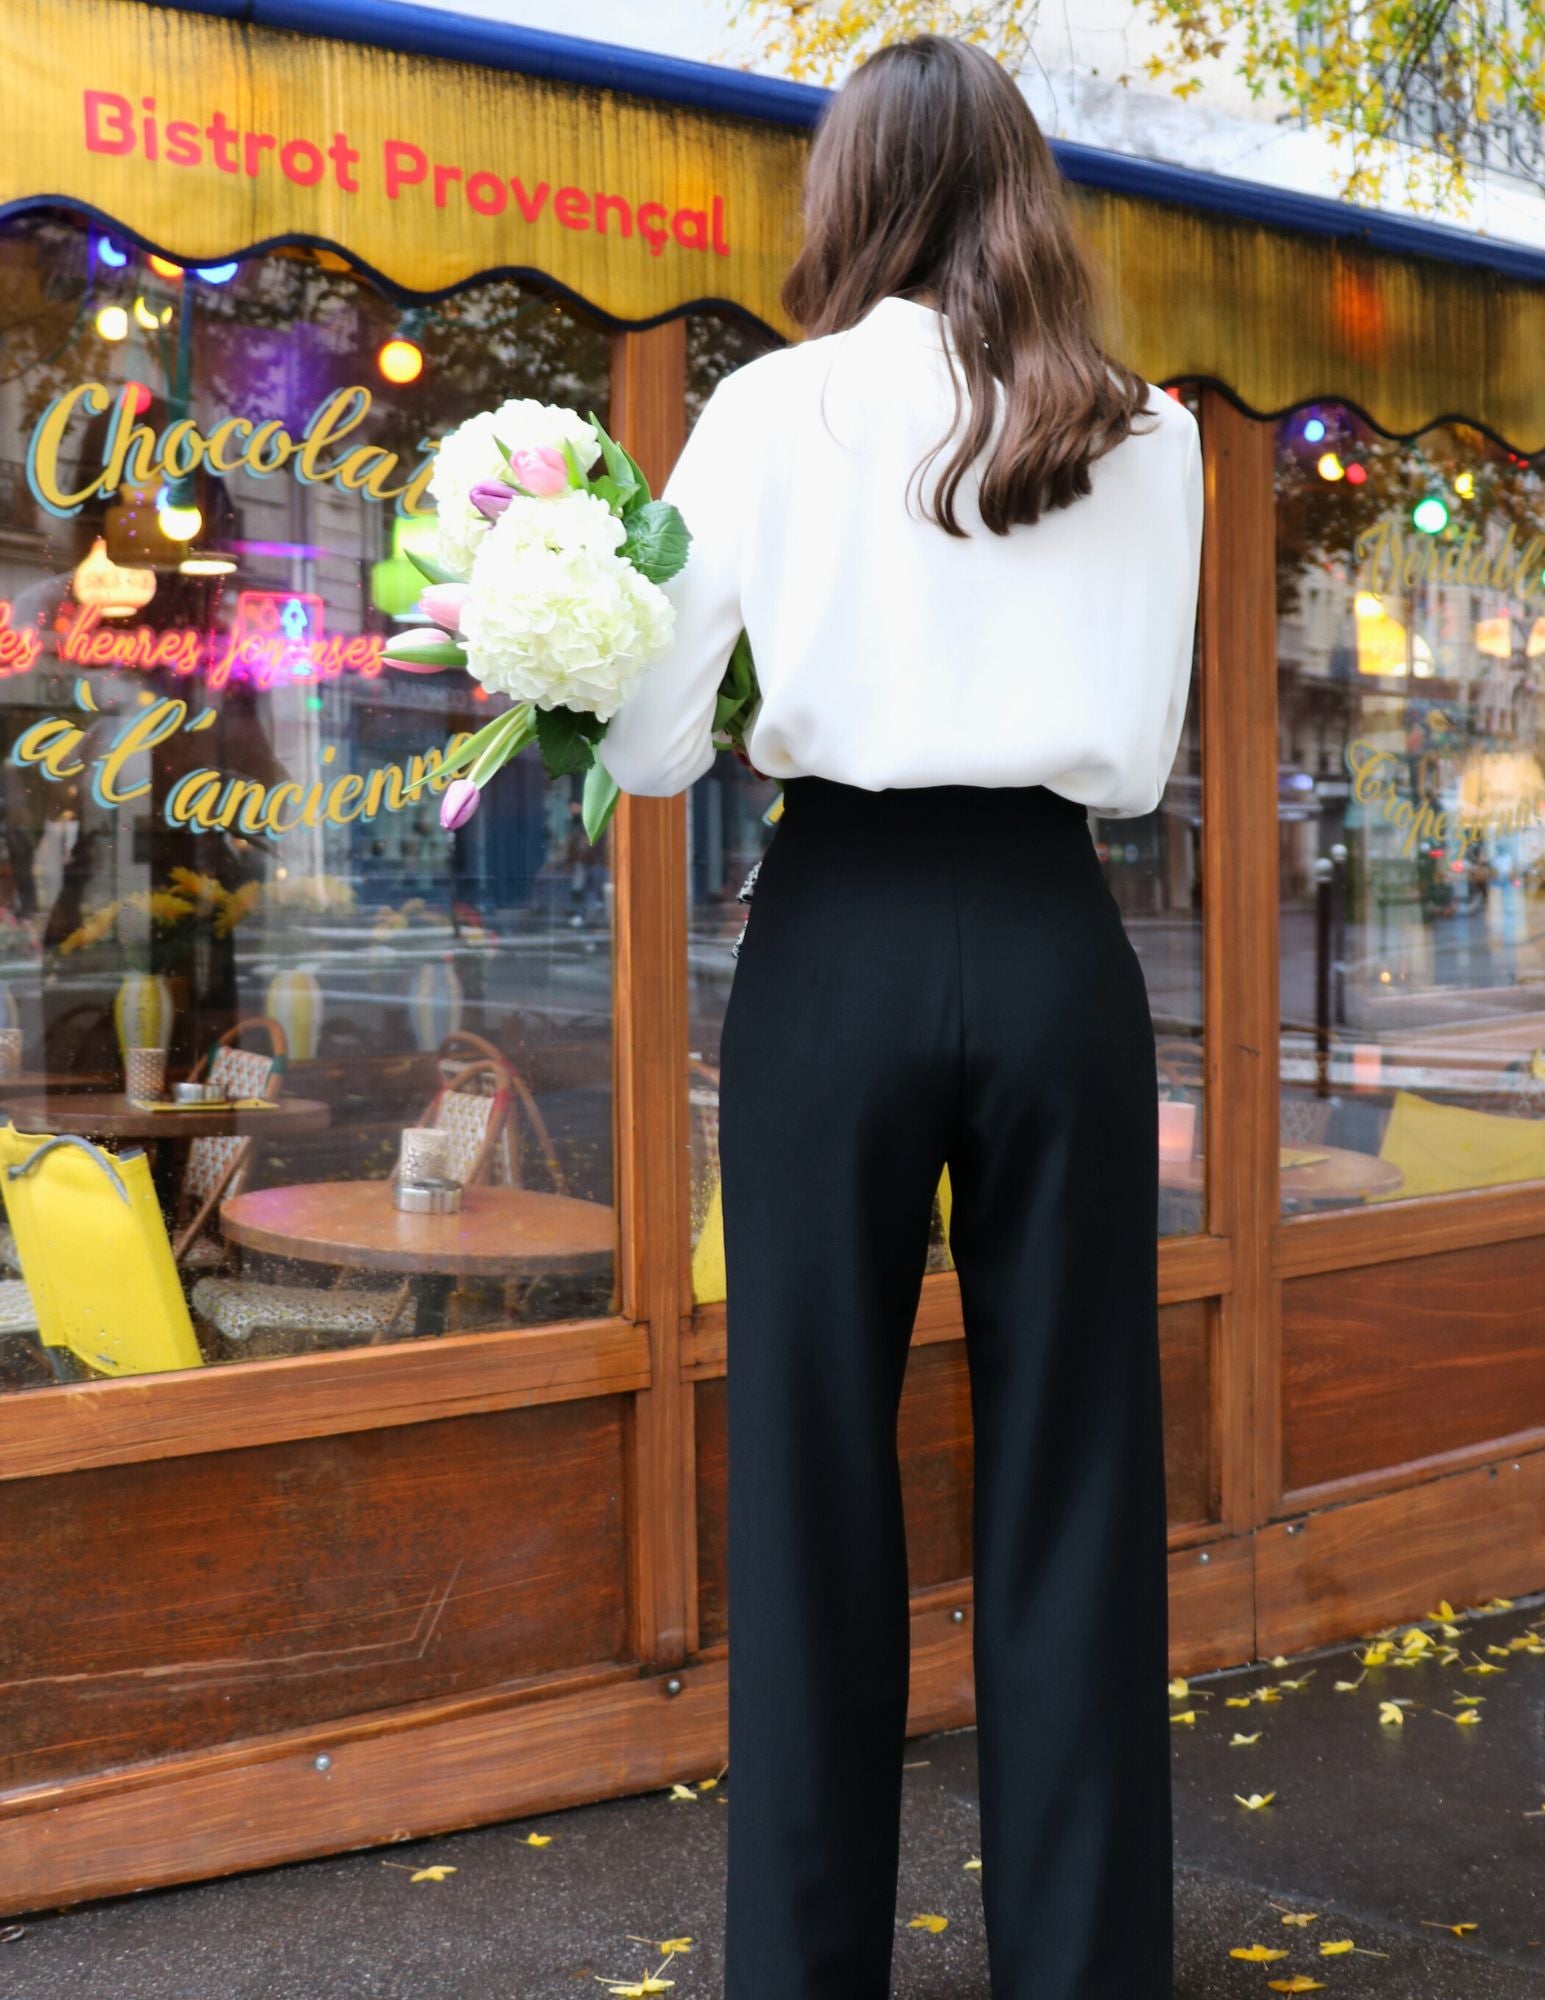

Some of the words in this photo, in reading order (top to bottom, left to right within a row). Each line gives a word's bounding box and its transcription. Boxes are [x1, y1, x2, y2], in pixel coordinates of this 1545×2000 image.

[82, 90, 359, 193] Bistrot
[383, 139, 732, 258] Provençal
[63, 600, 202, 677] heures
[12, 678, 98, 782] à
